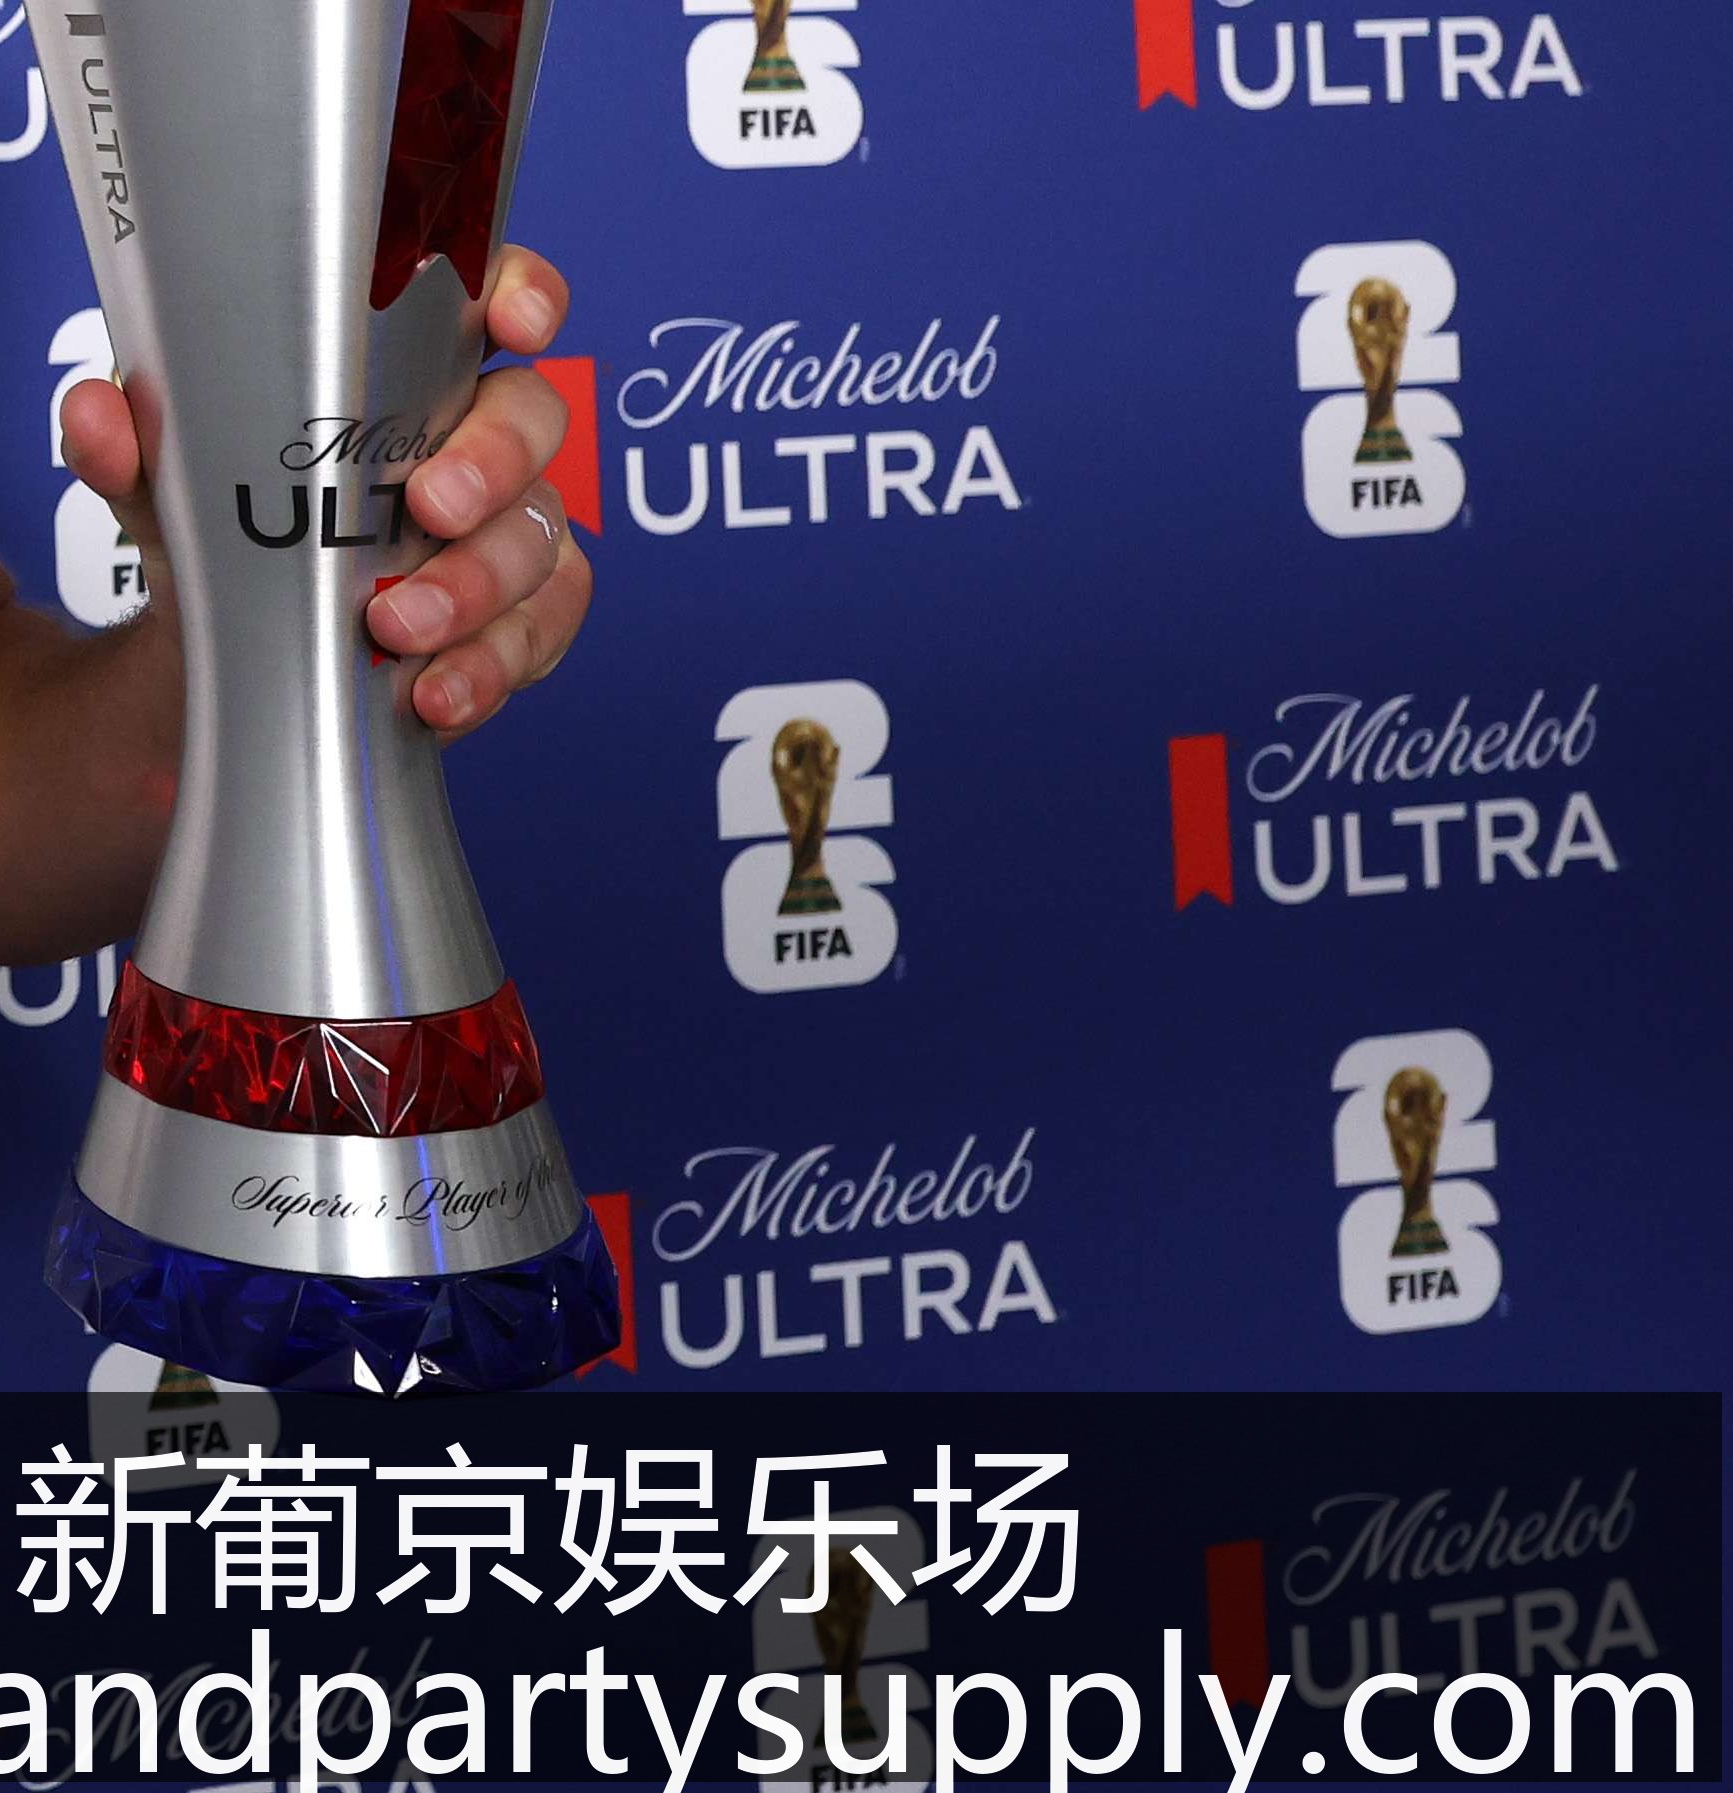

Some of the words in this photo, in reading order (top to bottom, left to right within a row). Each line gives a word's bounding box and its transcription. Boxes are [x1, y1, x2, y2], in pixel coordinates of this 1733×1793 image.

[1216, 14, 1582, 110] ULTRA
[80, 57, 136, 244] ULTRA
[739, 107, 816, 139] FIFA
[617, 314, 1000, 429] Michelob
[235, 481, 408, 550] ULT
[625, 425, 1022, 535] ULTRA
[1351, 477, 1423, 509] FIFA
[1247, 684, 1598, 802] Michelob
[1254, 792, 1618, 904] ULTRA
[774, 926, 853, 964] FIFA
[231, 1175, 389, 1228] Superir
[395, 1176, 508, 1232] Player
[653, 1127, 1035, 1262] Michelob
[660, 1240, 1057, 1369] ULTRA
[1387, 1268, 1459, 1304] FIFA
